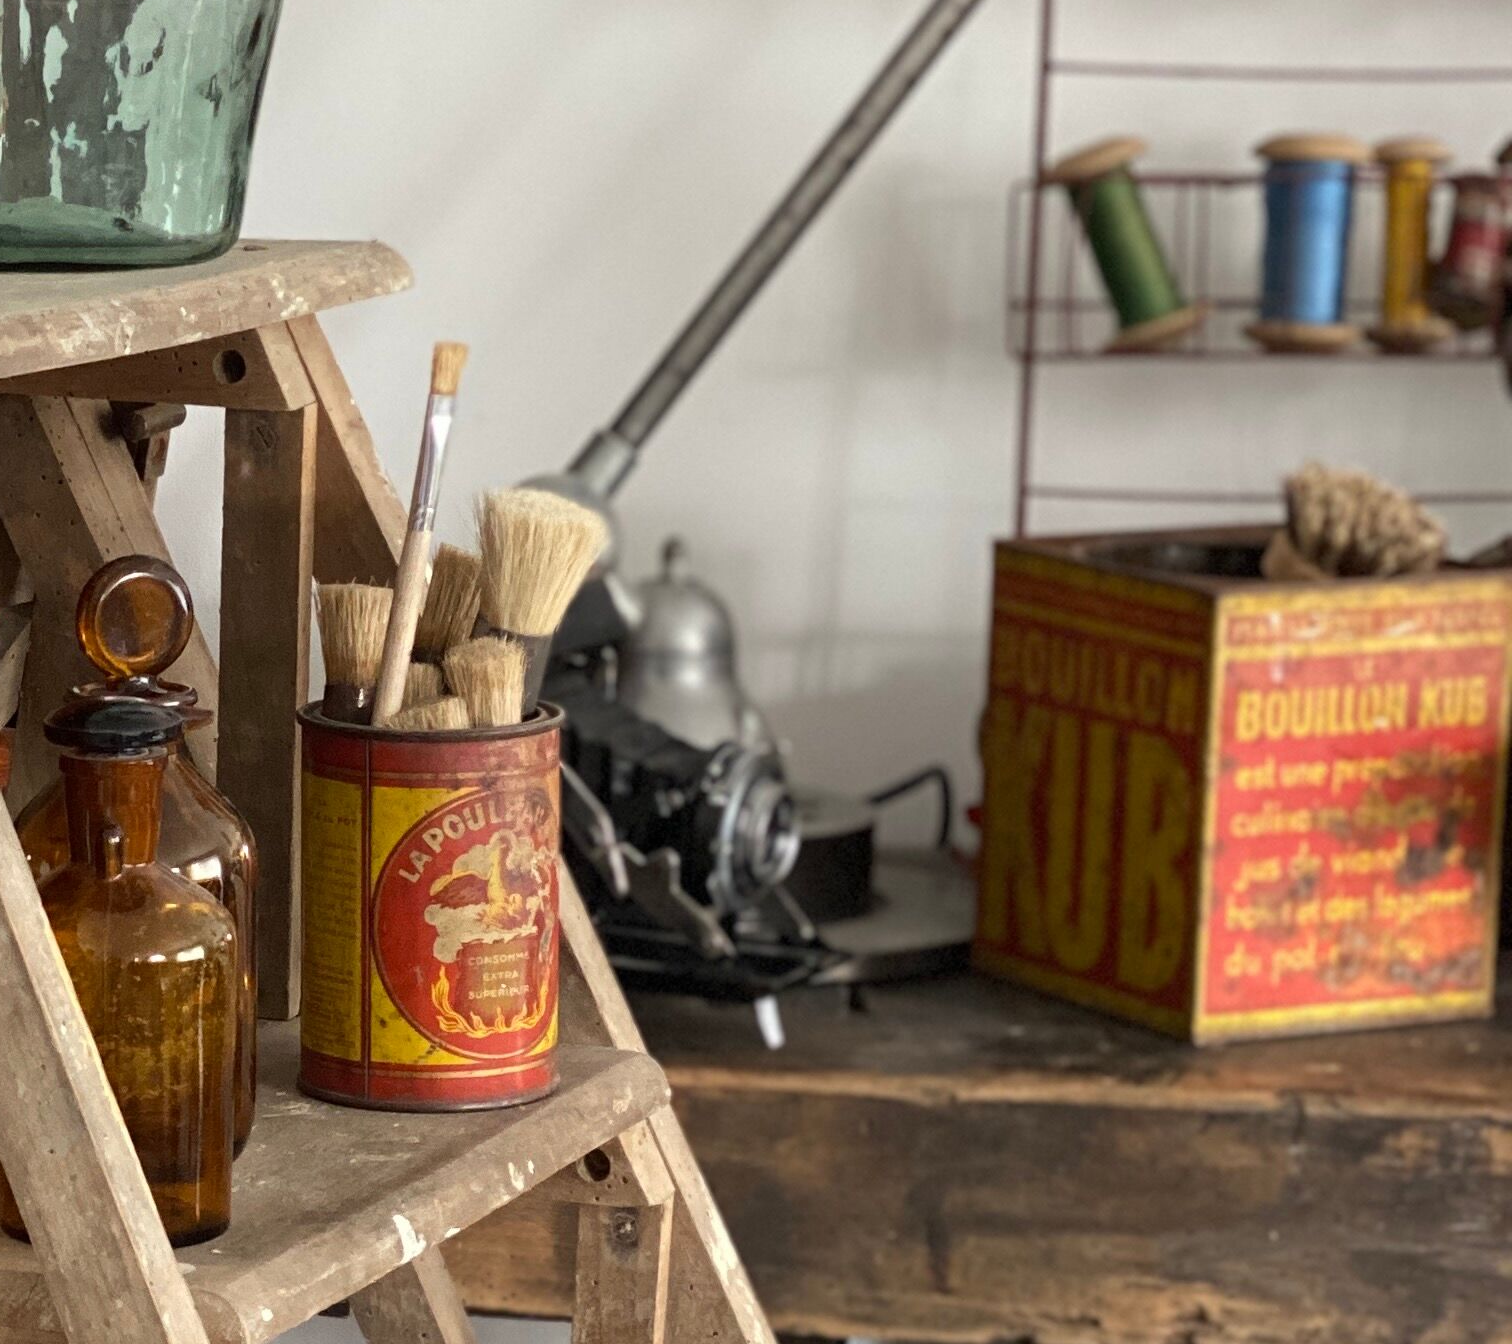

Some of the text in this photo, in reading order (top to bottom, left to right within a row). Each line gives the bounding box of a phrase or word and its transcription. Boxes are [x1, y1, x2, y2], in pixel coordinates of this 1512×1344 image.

[1236, 675, 1487, 742] BOUILLON KUB
[398, 850, 433, 884] LA
[980, 694, 1192, 993] KUB
